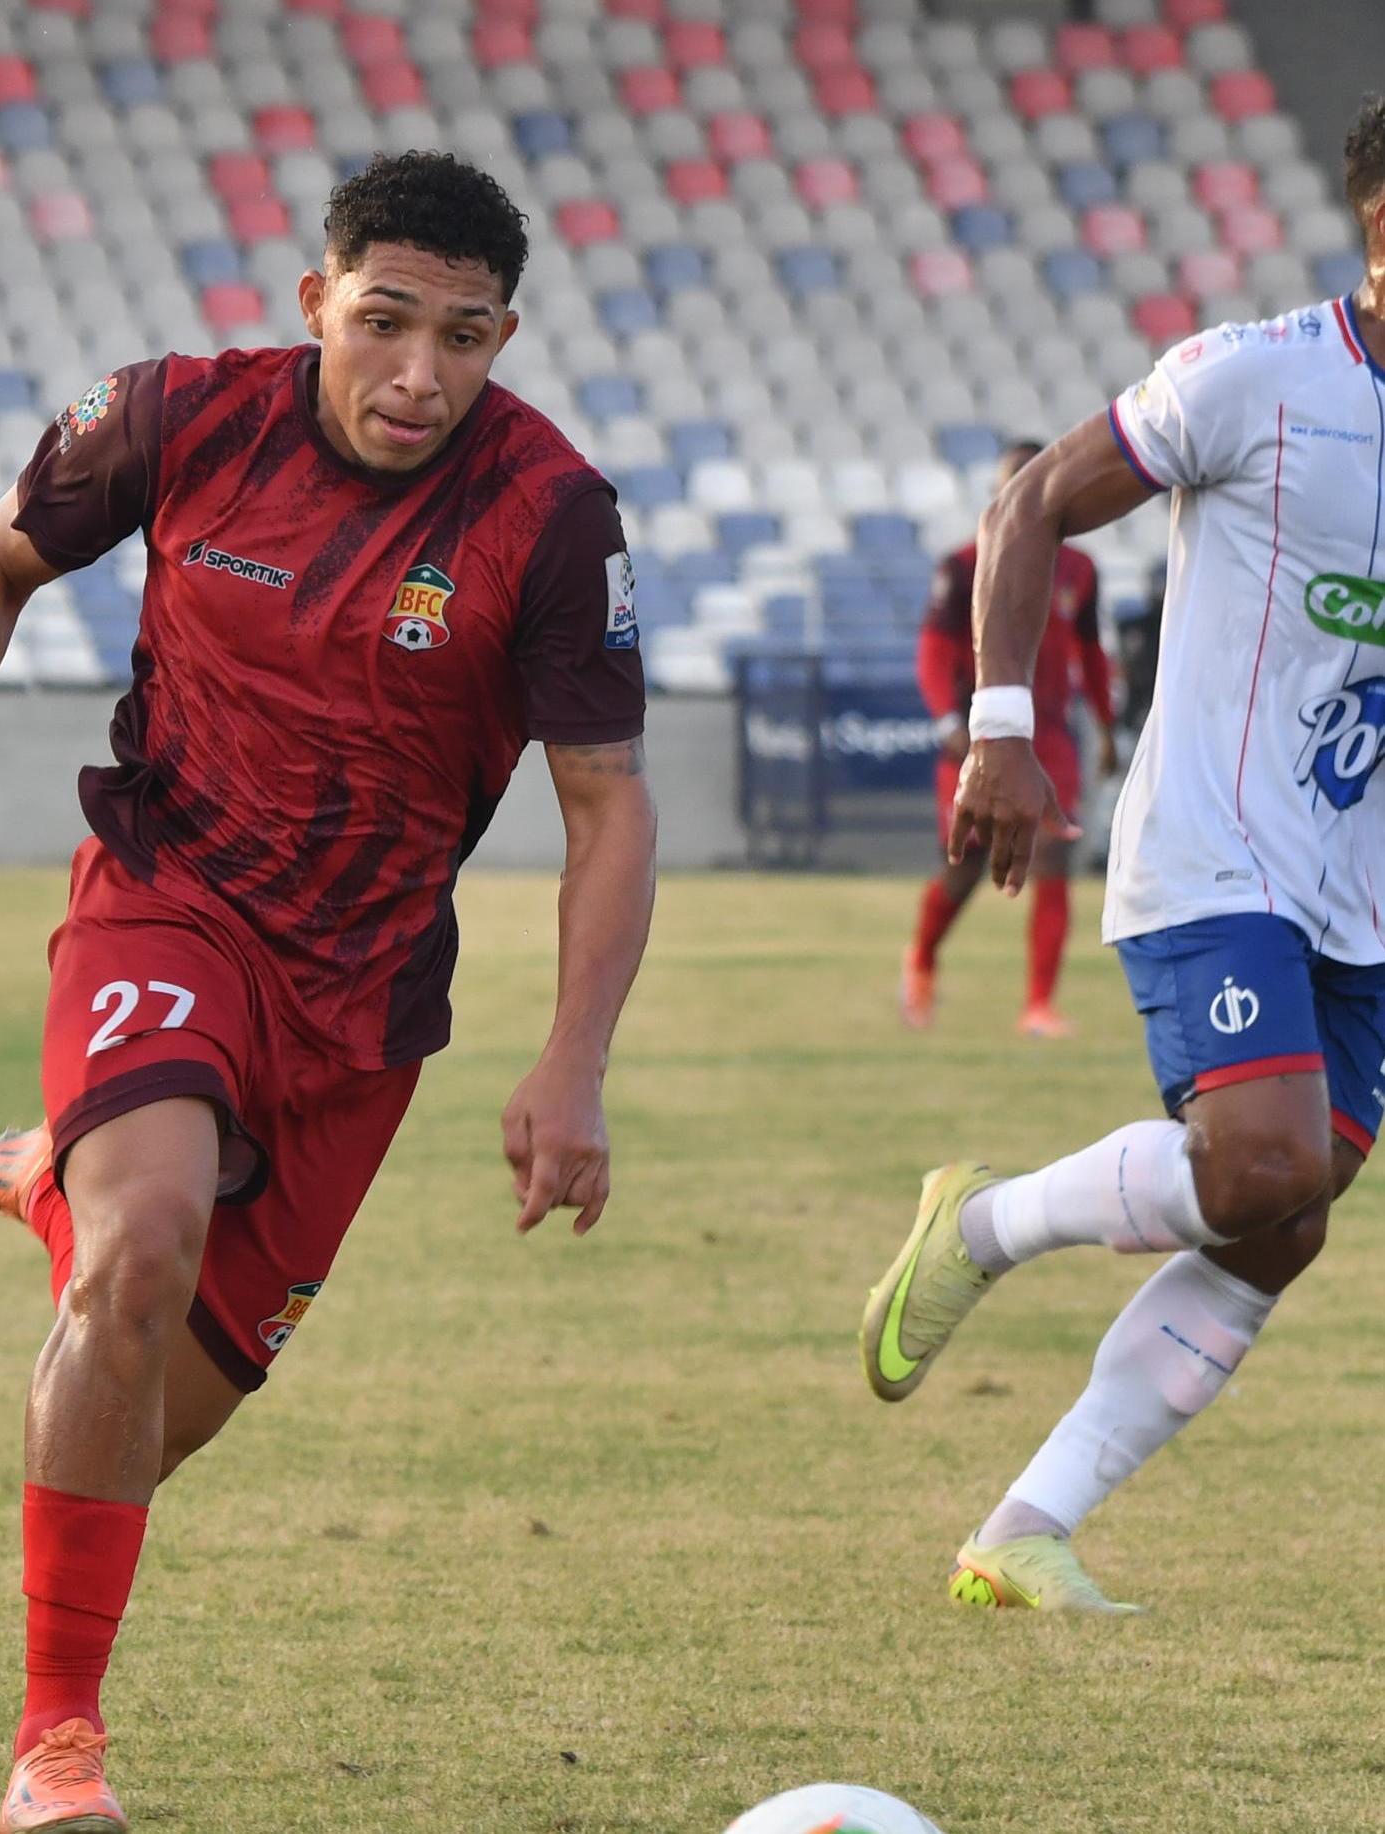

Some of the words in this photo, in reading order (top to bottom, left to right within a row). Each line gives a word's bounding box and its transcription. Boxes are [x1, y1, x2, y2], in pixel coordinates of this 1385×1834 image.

[205, 549, 287, 589] SPORTIK
[399, 588, 442, 617] BFC
[86, 980, 196, 1057] 27
